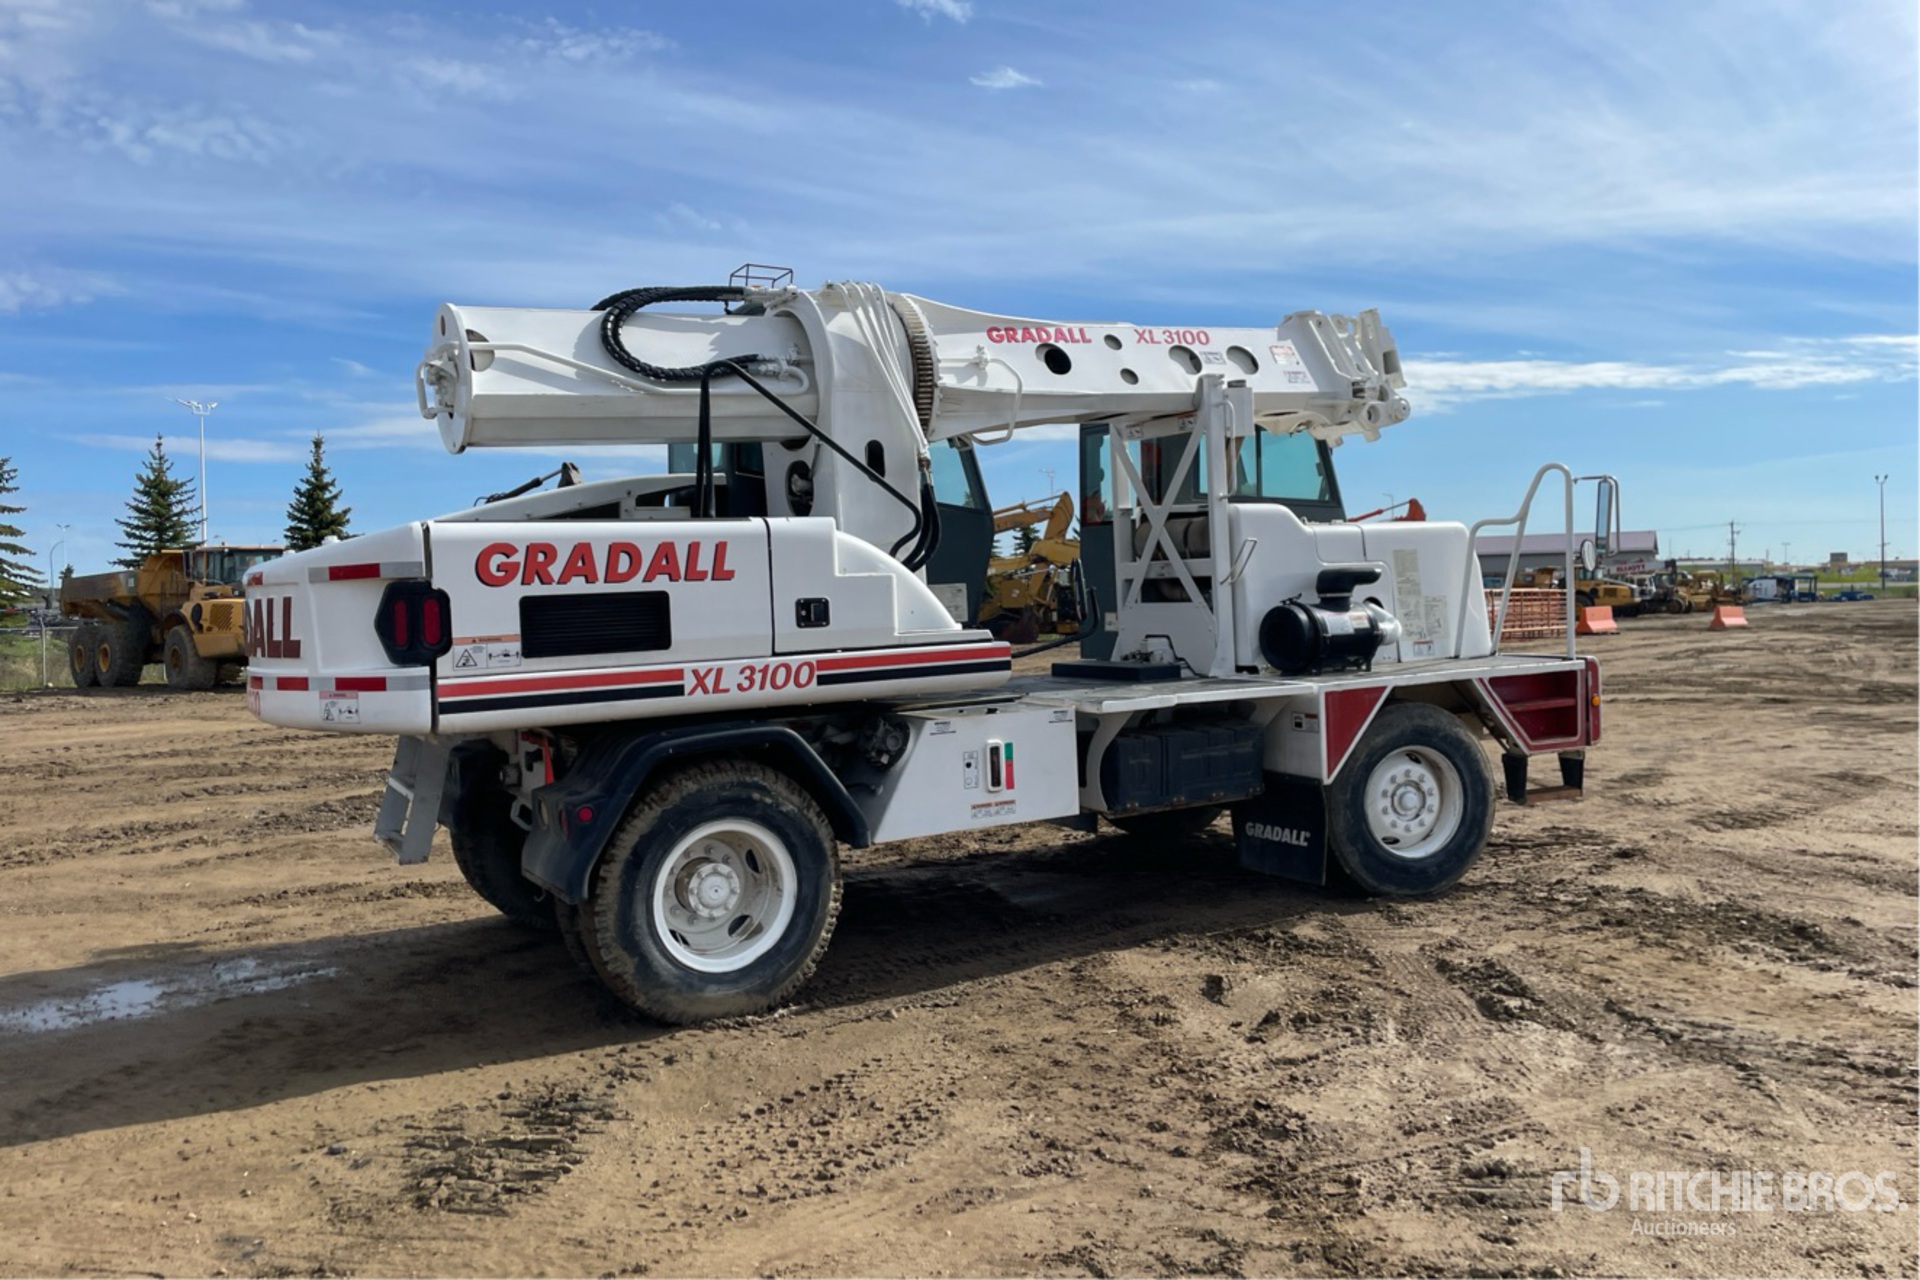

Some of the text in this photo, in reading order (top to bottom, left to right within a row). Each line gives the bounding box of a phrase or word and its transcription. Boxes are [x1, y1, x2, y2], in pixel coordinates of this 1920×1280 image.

[986, 326, 1092, 344] GRADALL
[1134, 329, 1210, 346] XL 3100
[475, 541, 735, 587] GRADALL
[688, 661, 815, 696] XL 3100
[1245, 822, 1309, 847] GRADALL
